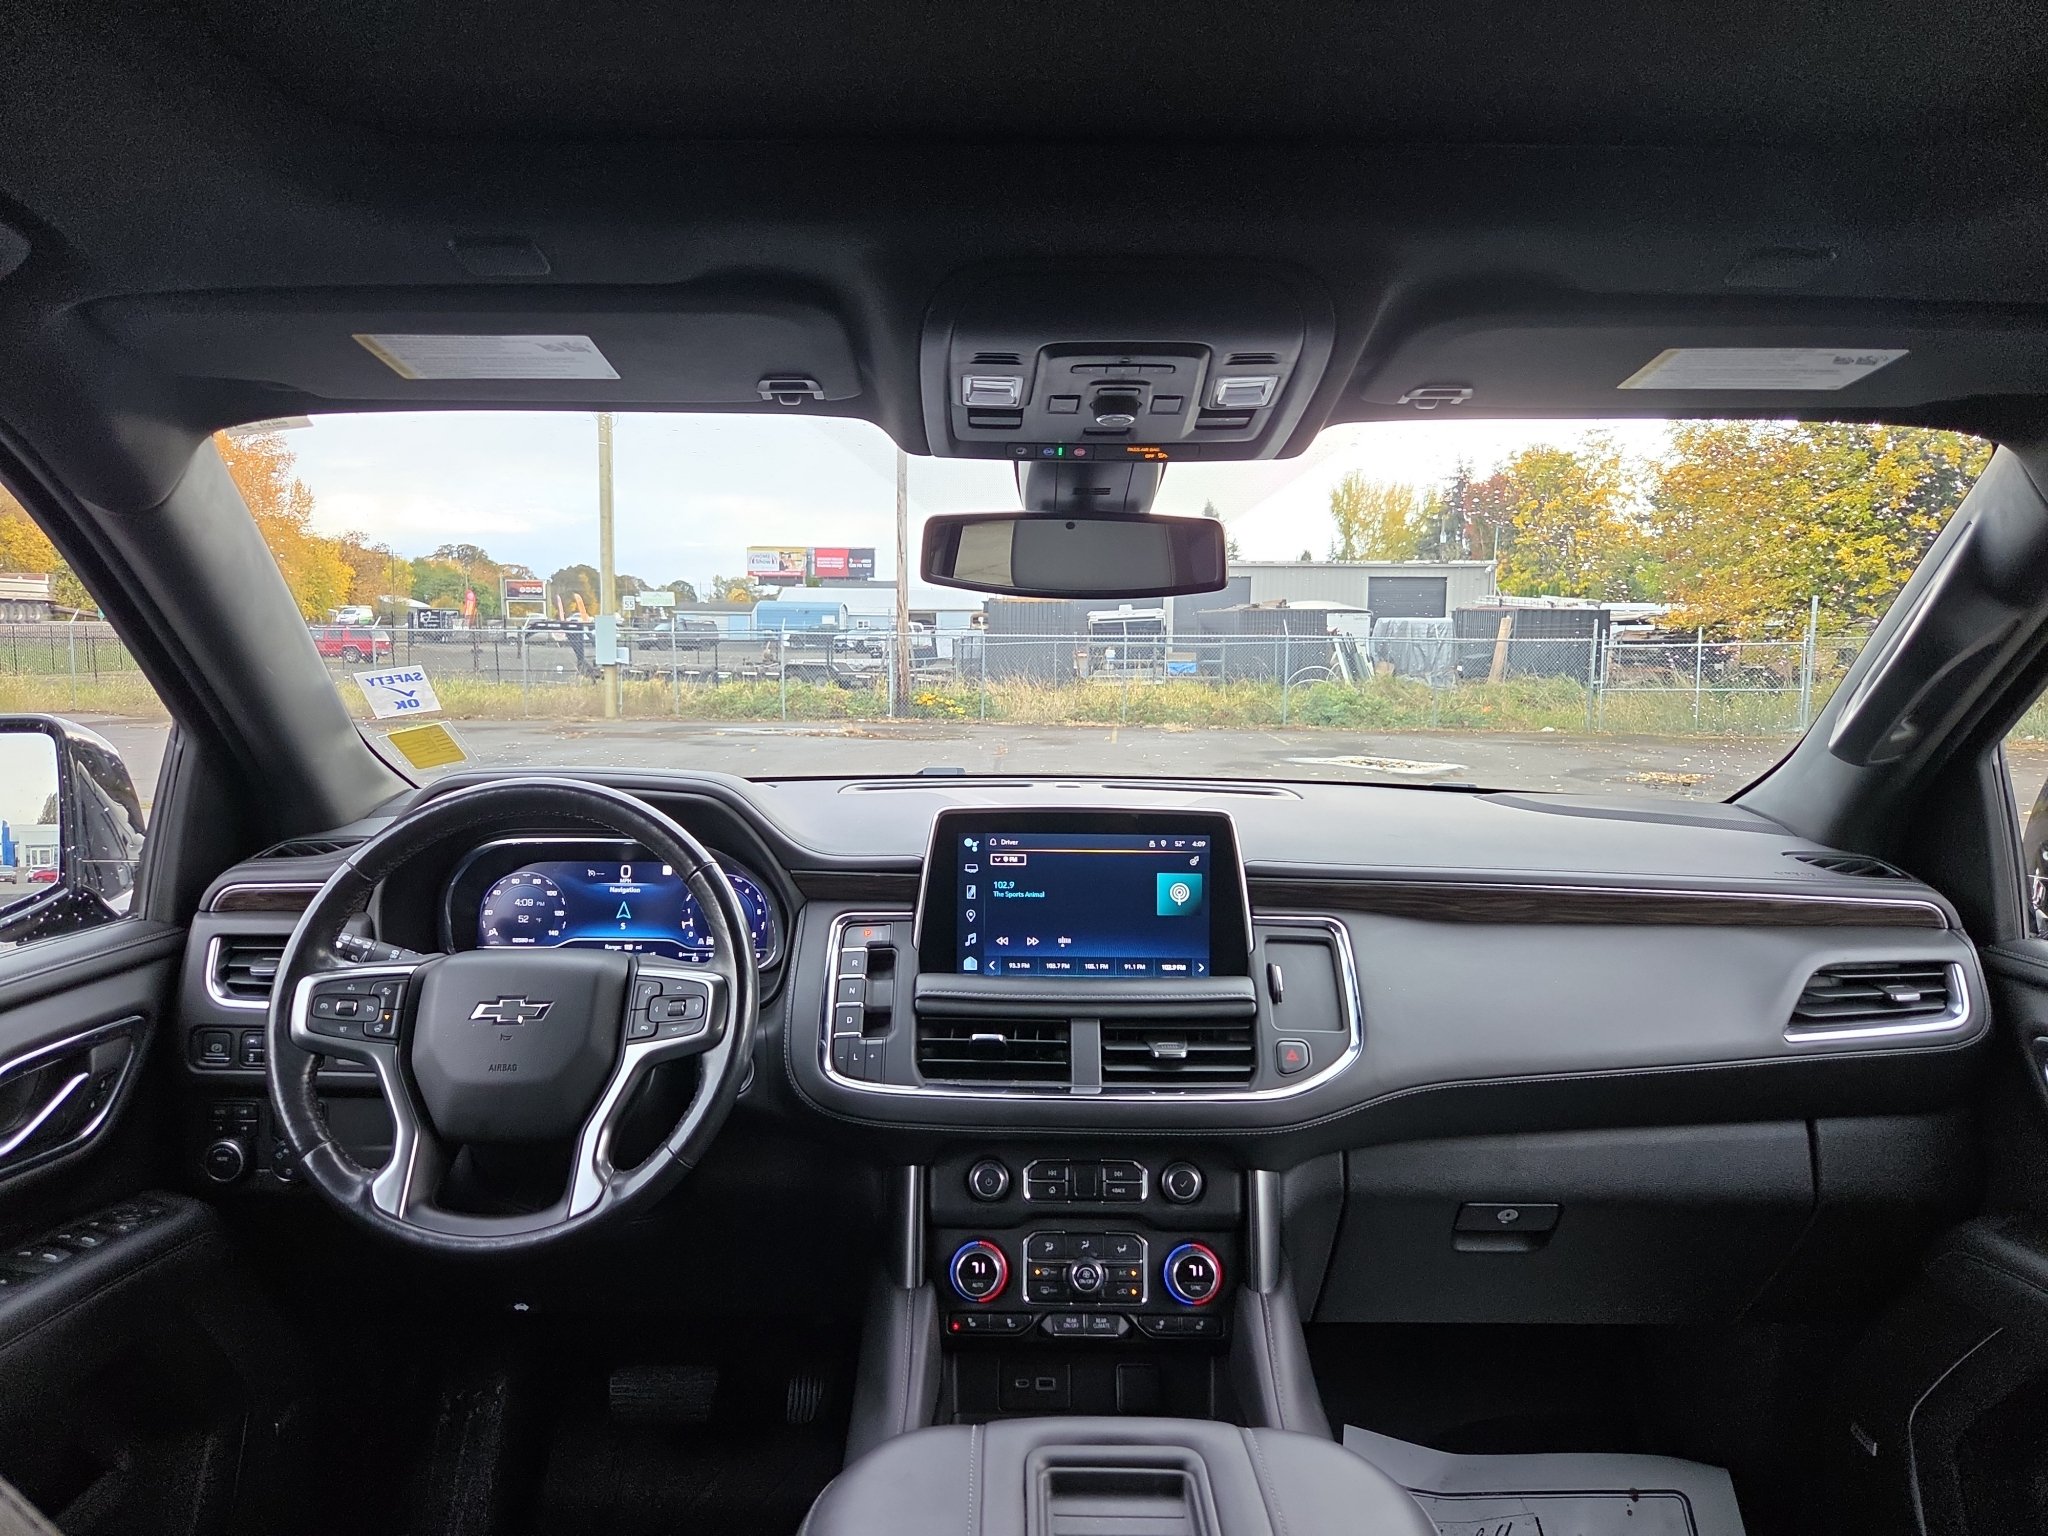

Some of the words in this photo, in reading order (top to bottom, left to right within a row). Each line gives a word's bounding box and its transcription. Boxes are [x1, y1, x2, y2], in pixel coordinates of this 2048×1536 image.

[620, 865, 632, 878] 0
[994, 881, 1015, 889] 102.9
[518, 915, 529, 923] 52
[972, 1262, 985, 1274] 71
[1189, 1265, 1203, 1276] 71
